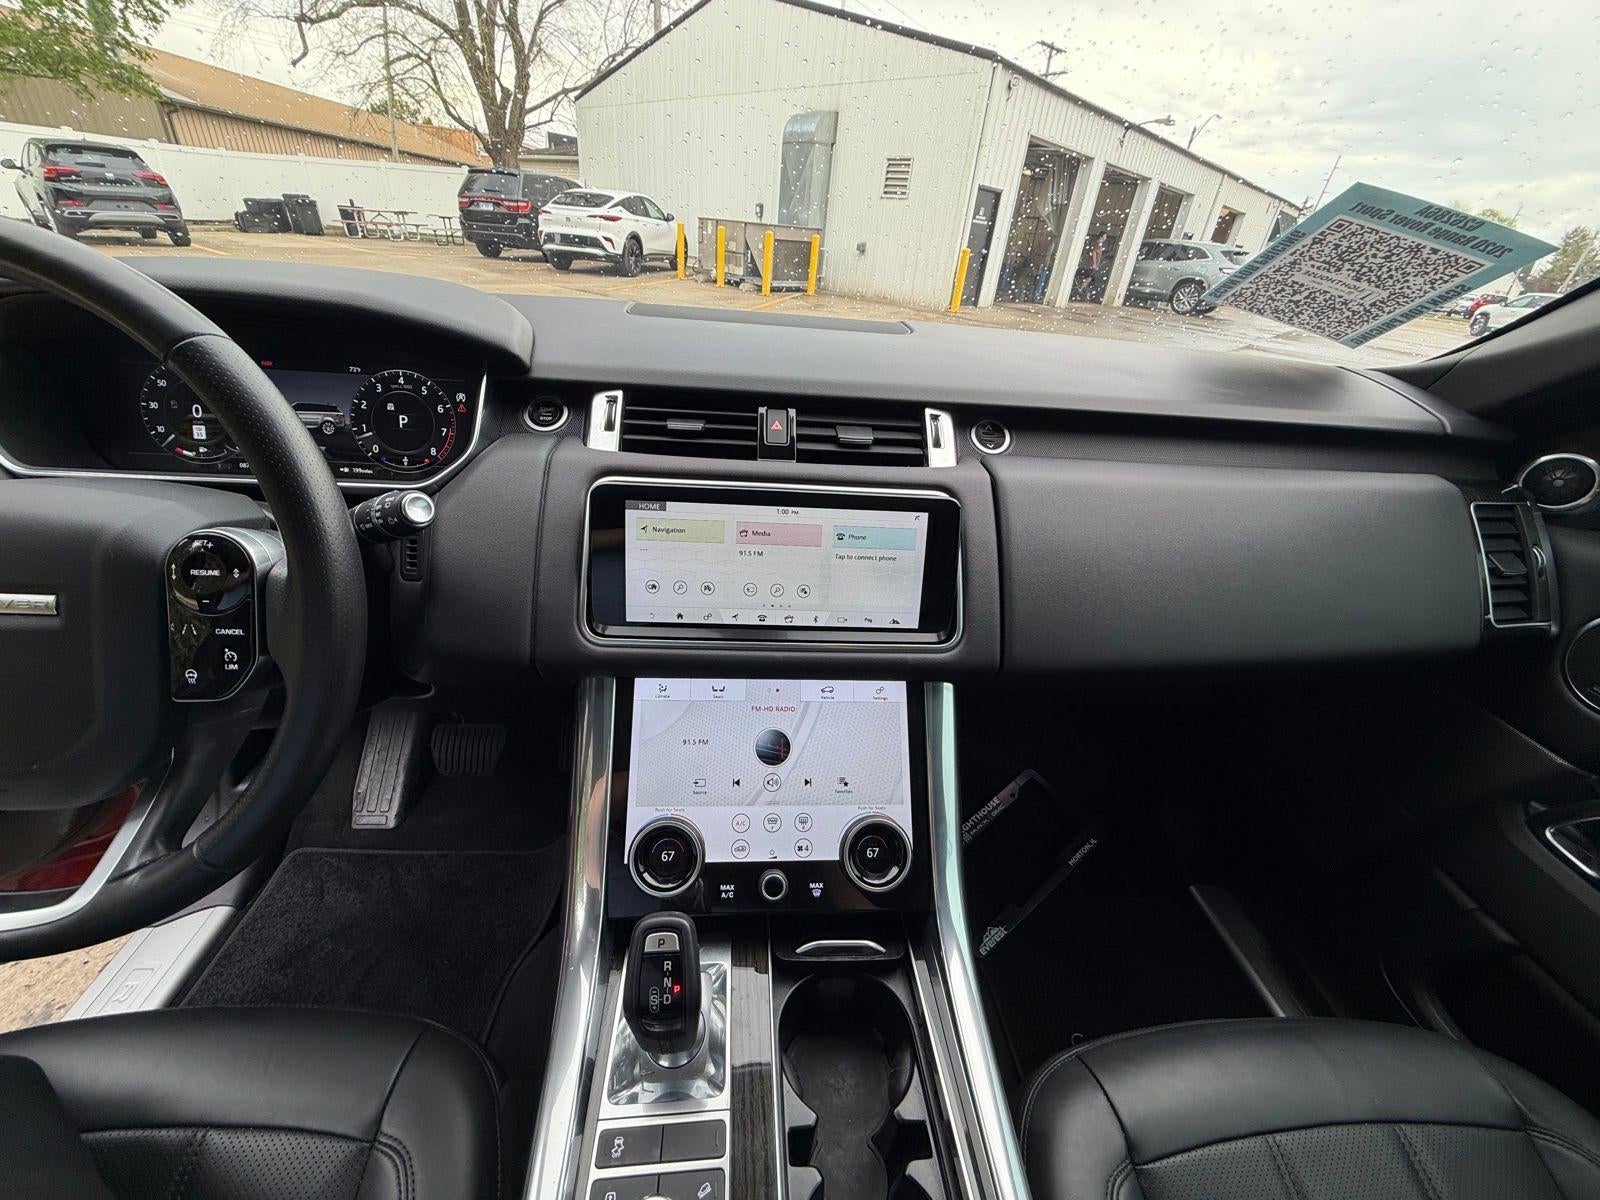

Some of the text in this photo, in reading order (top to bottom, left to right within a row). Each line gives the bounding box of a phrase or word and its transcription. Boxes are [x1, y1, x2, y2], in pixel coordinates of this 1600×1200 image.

[156, 379, 167, 387] 50
[398, 376, 405, 385] 4
[375, 383, 383, 393] 3
[420, 386, 428, 395] 5
[148, 401, 159, 409] 30
[360, 400, 368, 409] 2
[437, 404, 444, 413] 6
[191, 404, 203, 418] 0
[398, 415, 409, 428] P
[361, 424, 367, 432] 1
[441, 427, 447, 436] 7
[372, 444, 379, 453] 0
[430, 447, 437, 456] 8
[639, 503, 661, 511] HOME
[652, 526, 687, 535] Navigation
[751, 530, 771, 538] Media
[848, 533, 867, 541] Phone
[835, 553, 846, 561] Tap
[854, 554, 877, 562] connect
[878, 555, 898, 563] phone
[190, 569, 221, 577] RESUME
[215, 628, 245, 636] CANCEL
[224, 663, 239, 671] LIM
[751, 705, 796, 713] FM-HD RADIO
[682, 738, 709, 746] 91.5 FM
[962, 796, 1001, 834] GHTHOUSE
[804, 844, 810, 852] 4
[866, 847, 880, 858] 67
[661, 850, 675, 862] 67
[720, 891, 734, 899] A/C
[657, 938, 666, 949] P
[979, 926, 1008, 956] everest
[663, 960, 672, 972] R
[663, 976, 672, 988] N
[673, 985, 681, 993] P
[650, 994, 658, 1005] S
[663, 994, 672, 1005] D
